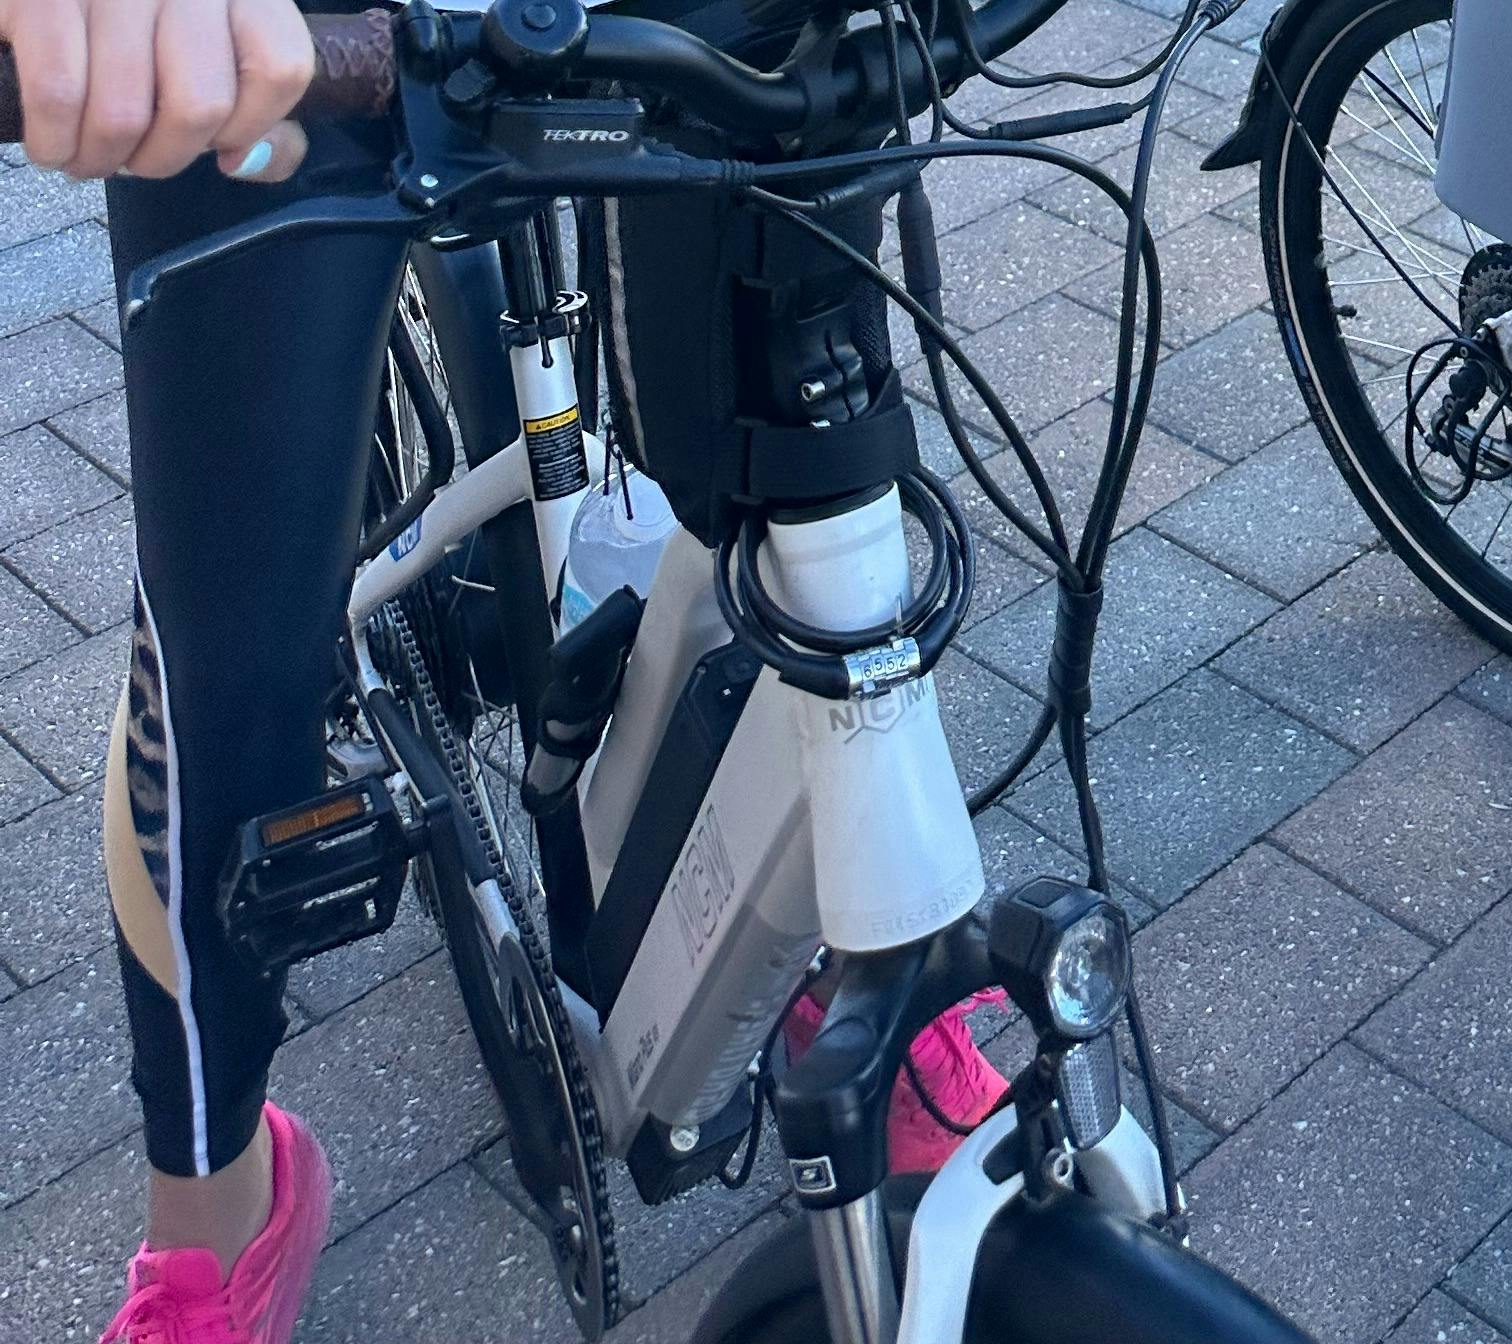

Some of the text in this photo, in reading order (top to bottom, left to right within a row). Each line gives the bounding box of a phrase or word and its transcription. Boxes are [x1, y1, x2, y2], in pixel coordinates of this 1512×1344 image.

[543, 129, 630, 142] TEKTRO
[863, 653, 907, 679] 6552
[670, 802, 736, 969] NCM
